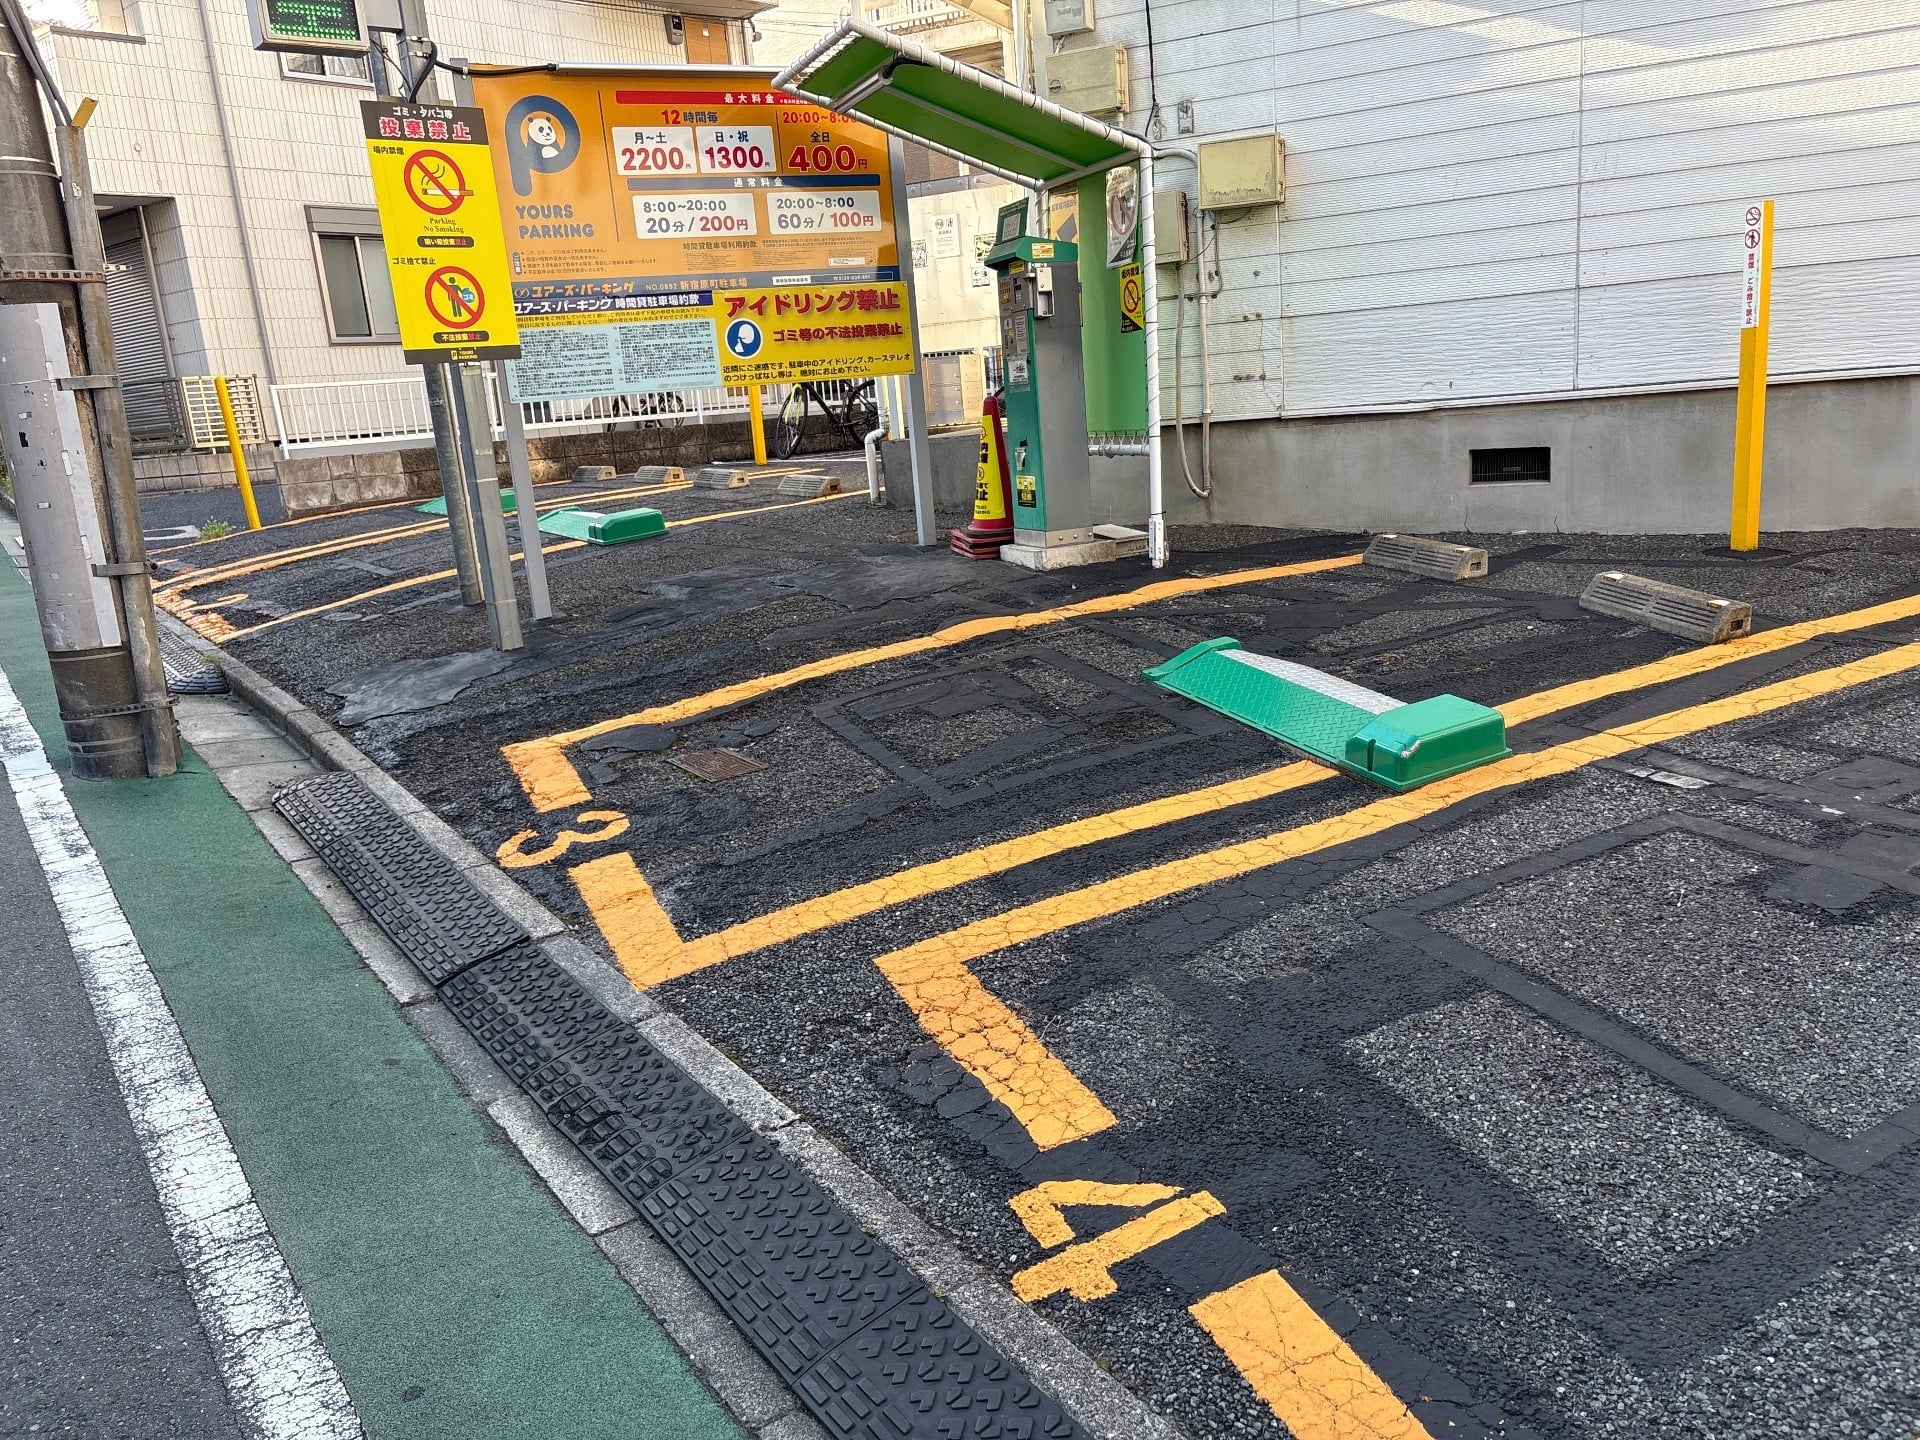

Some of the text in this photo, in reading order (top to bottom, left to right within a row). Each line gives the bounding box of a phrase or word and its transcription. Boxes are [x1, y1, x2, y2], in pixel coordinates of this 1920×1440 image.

[724, 93, 775, 104] 最大料金
[392, 106, 453, 119] ゴミ・タバコ等
[379, 117, 471, 141] 投棄禁止
[810, 132, 830, 143] 全日
[734, 177, 784, 188] 通常料金
[515, 204, 574, 219] YOURS
[430, 218, 456, 226] Parking
[519, 223, 594, 239] PARKING
[724, 288, 900, 318] アイドリング禁止
[773, 323, 904, 342] ゴミ等の不法投棄禁止
[496, 809, 630, 869] 3
[1008, 1180, 1228, 1303] 4
